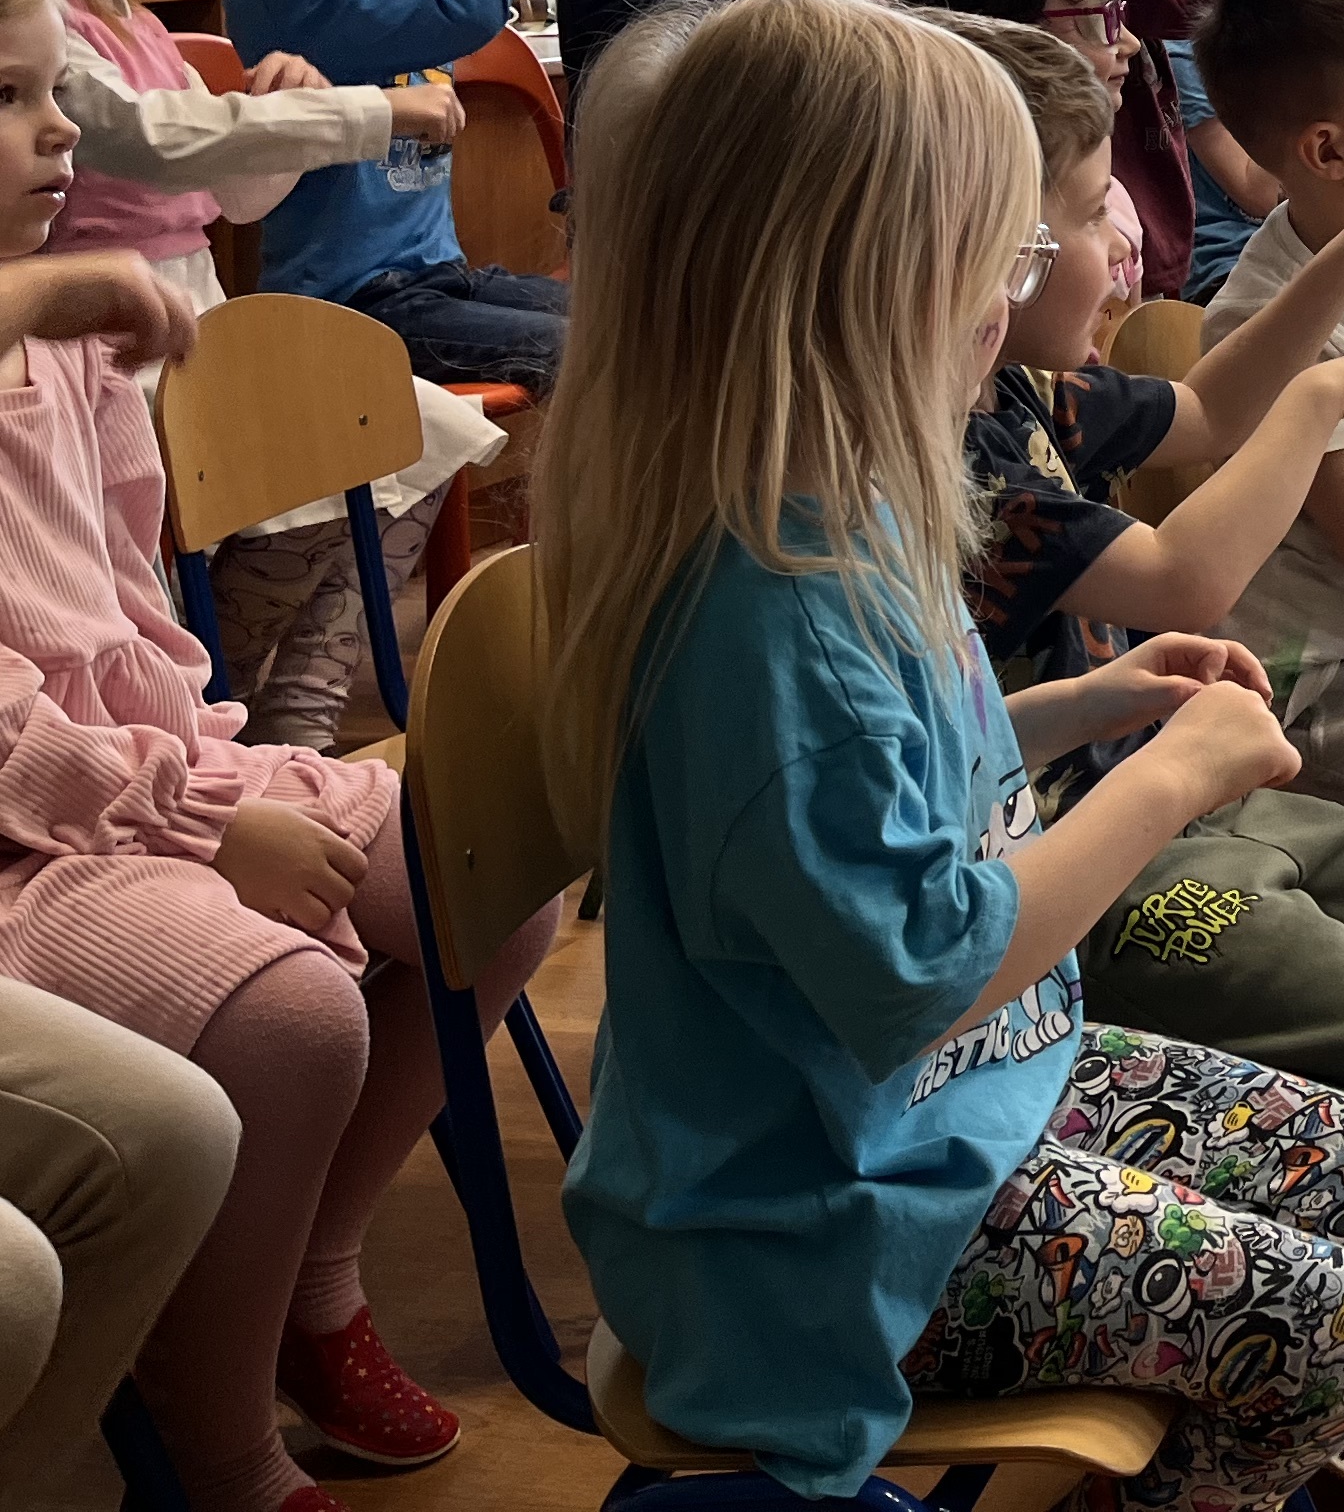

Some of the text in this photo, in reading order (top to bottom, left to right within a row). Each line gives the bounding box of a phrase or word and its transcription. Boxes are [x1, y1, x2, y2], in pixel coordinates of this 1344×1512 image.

[1114, 878, 1218, 957] TURTLE
[1161, 889, 1259, 963] POWER
[900, 1006, 1011, 1116] ASTIC
